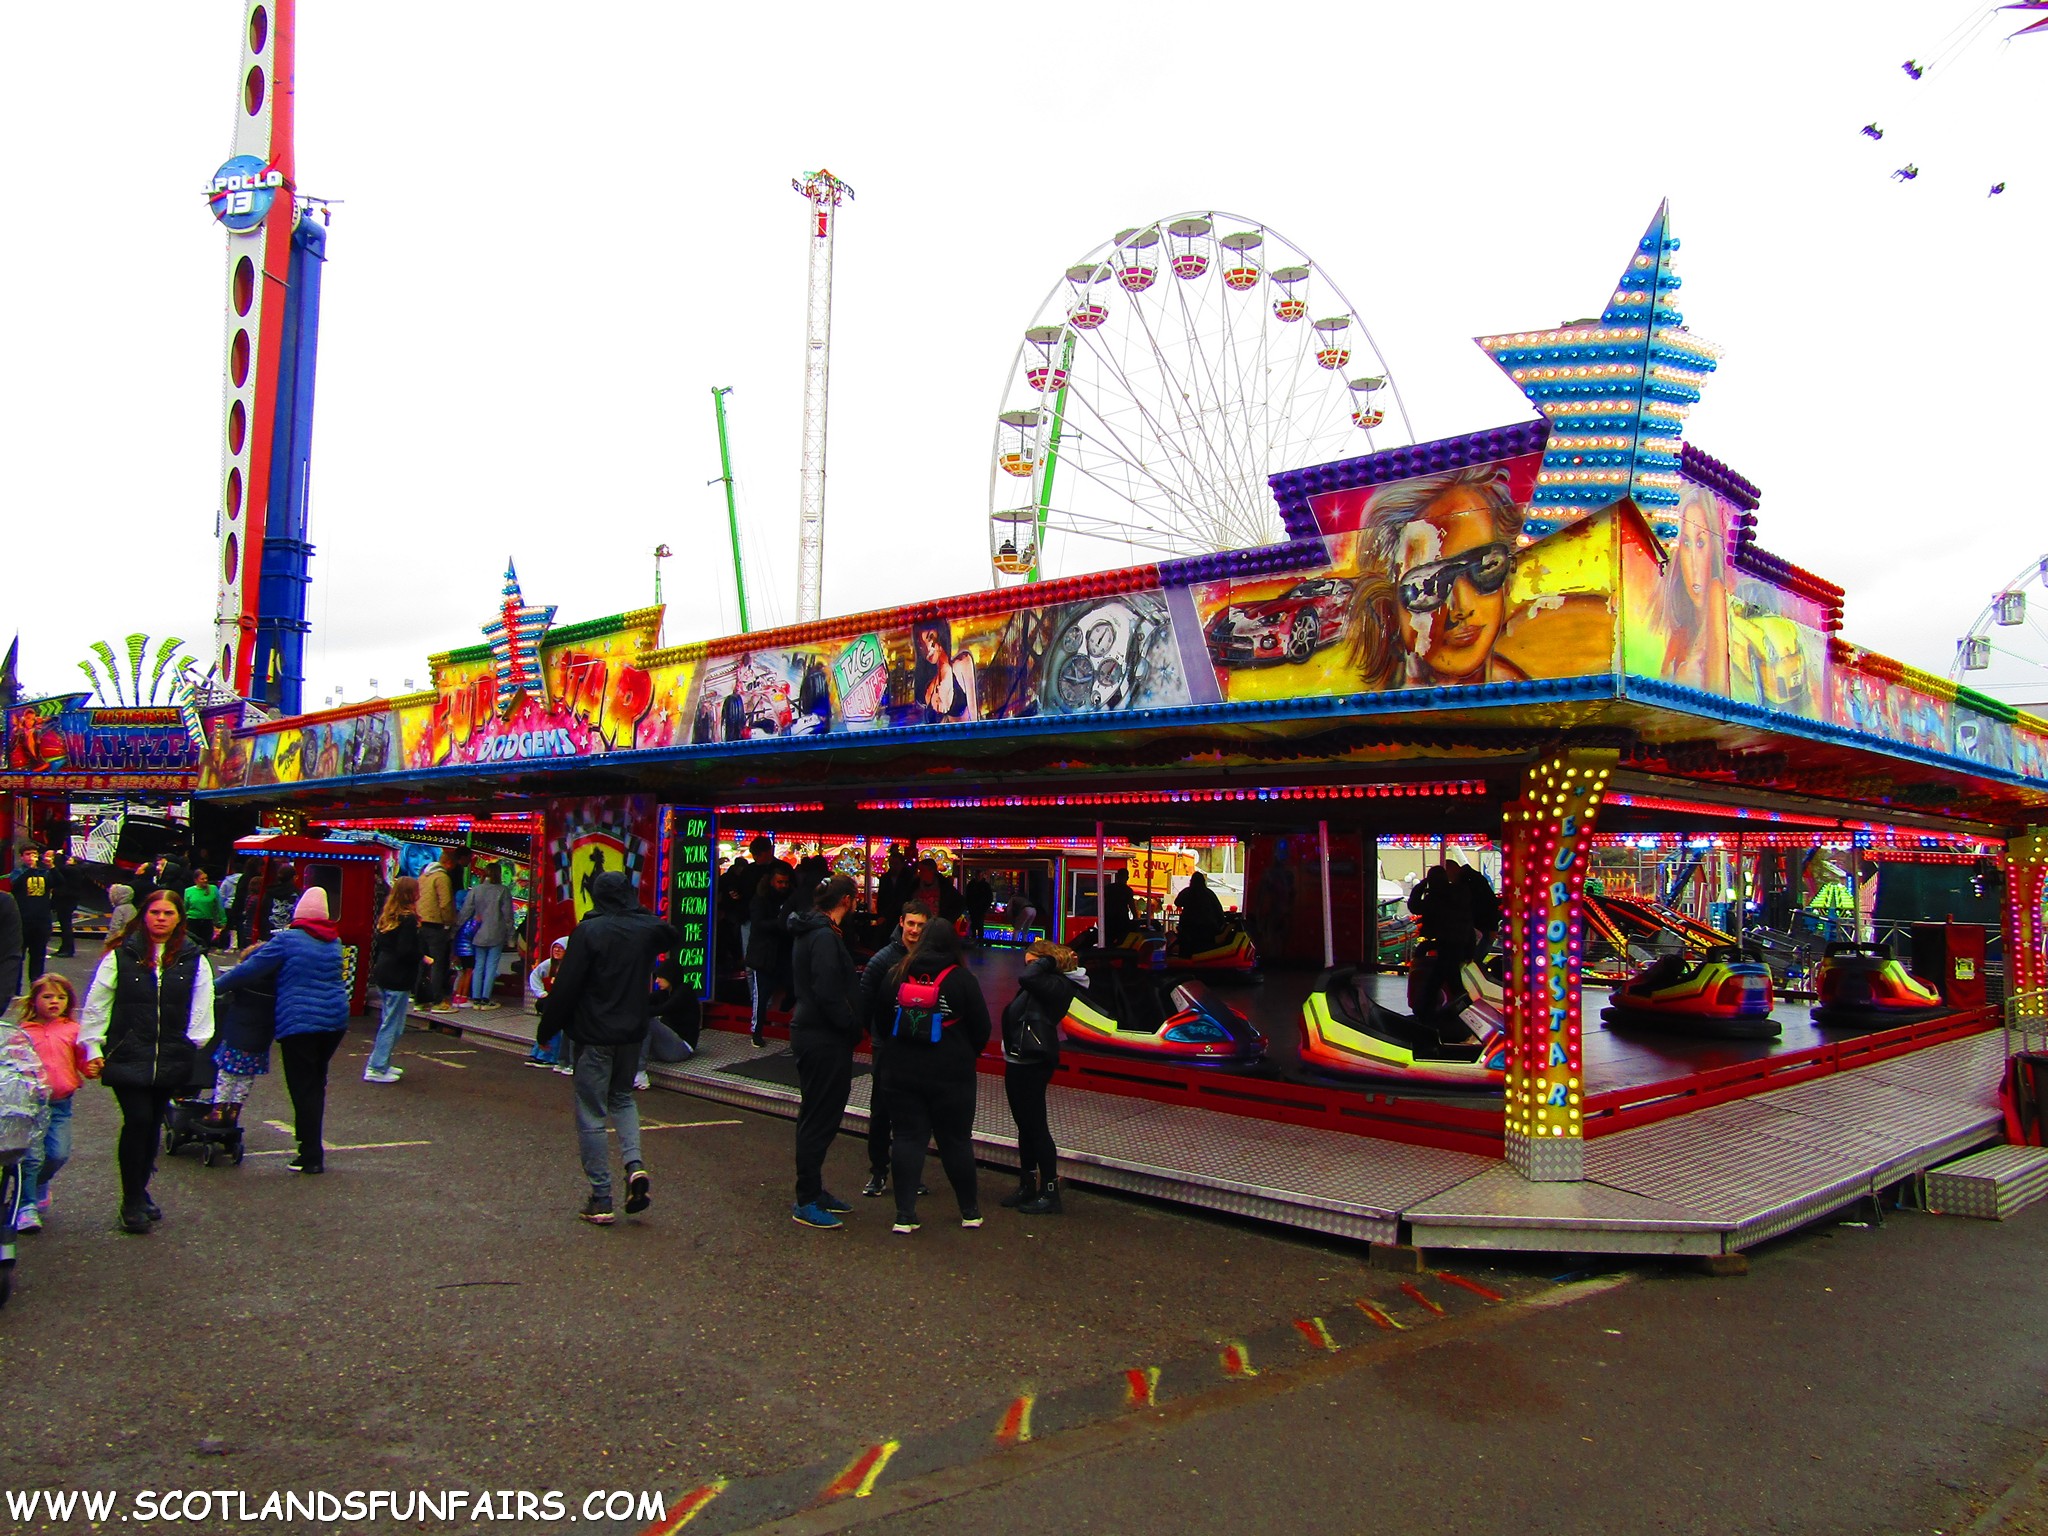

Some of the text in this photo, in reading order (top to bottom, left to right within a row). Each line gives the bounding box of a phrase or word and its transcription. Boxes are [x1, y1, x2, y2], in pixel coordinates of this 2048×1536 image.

[201, 170, 284, 195] APOLLO
[226, 191, 254, 216] 13
[840, 639, 874, 688] TAG
[844, 669, 887, 718] HEUER
[94, 710, 178, 724] ULTIMATE
[476, 728, 577, 762] DODGEMS
[686, 818, 707, 838] BUY
[683, 845, 709, 864] YOUR
[676, 870, 711, 890] TOKENS
[681, 896, 708, 917] FROM
[684, 922, 704, 942] THE
[679, 947, 705, 967] CASH
